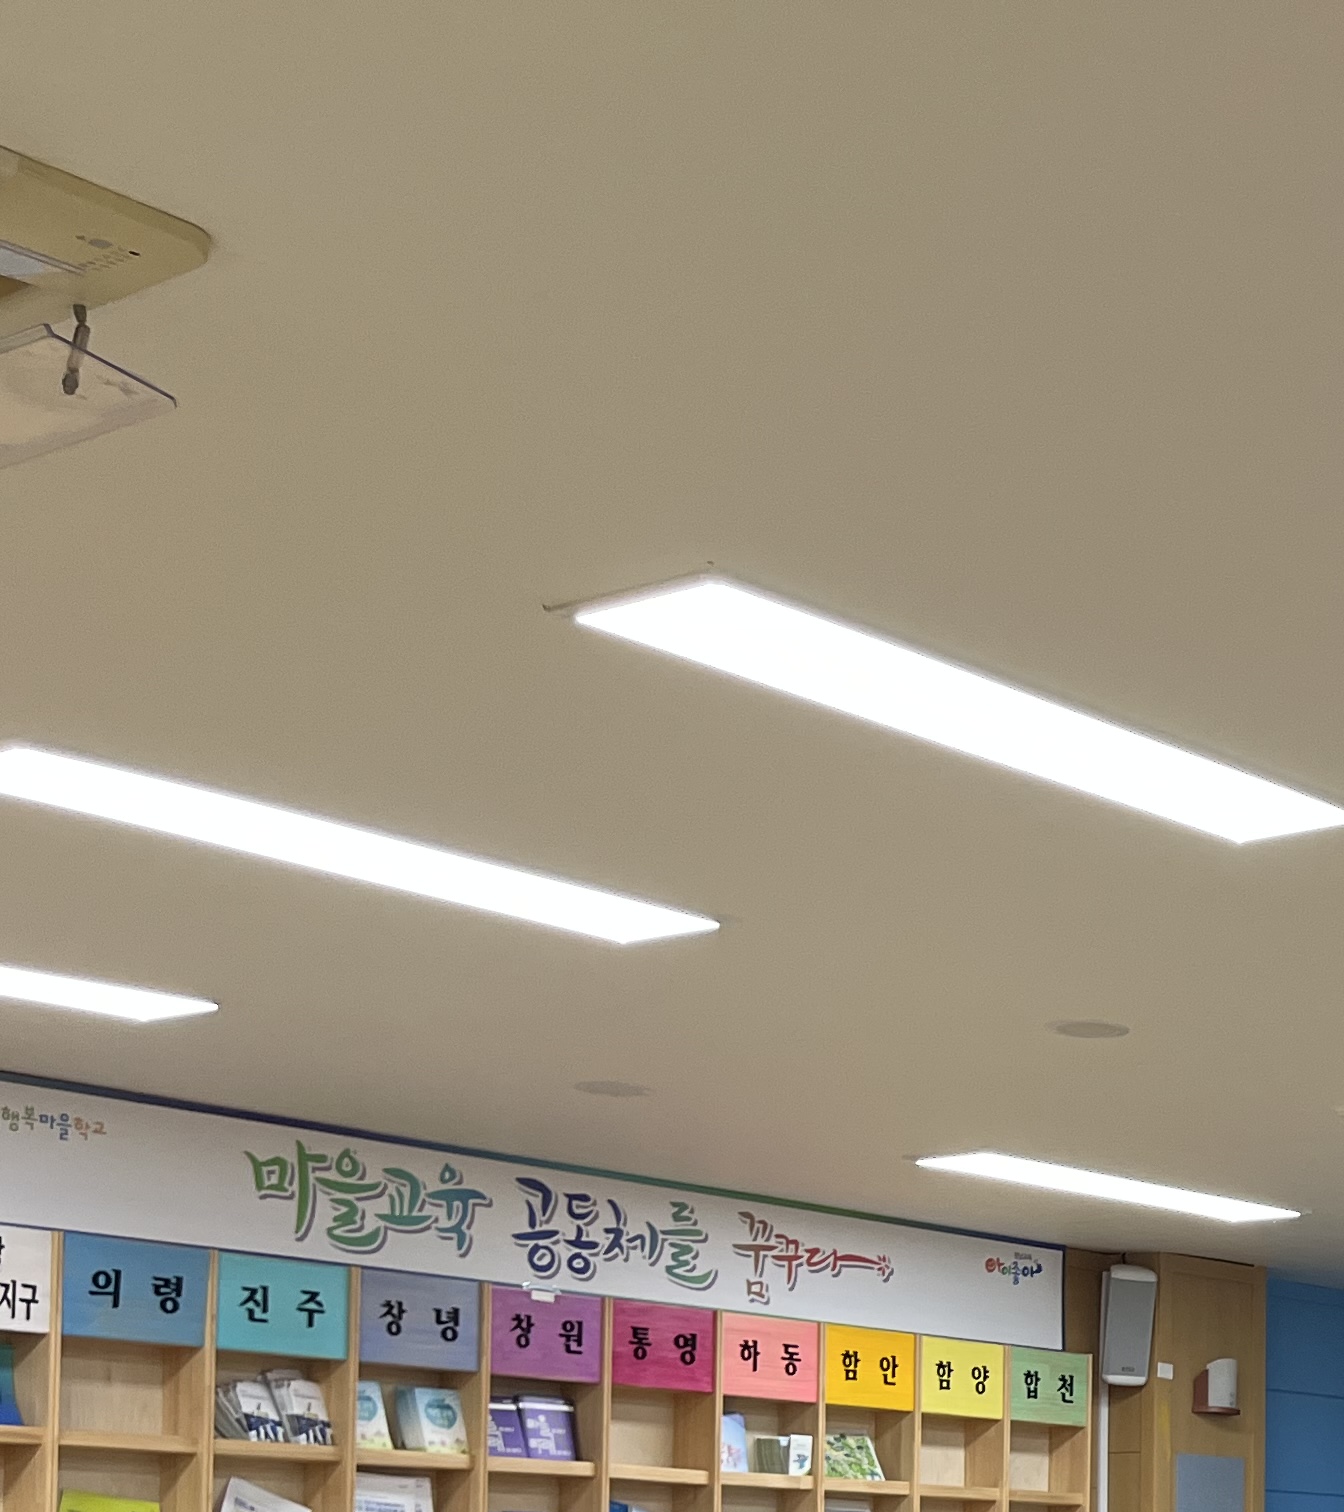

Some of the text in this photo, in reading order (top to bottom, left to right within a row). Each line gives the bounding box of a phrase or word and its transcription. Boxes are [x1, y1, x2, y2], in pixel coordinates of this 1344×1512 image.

[1, 1106, 107, 1141] 행복마을학교
[244, 1139, 893, 1304] 마을교육 공동체를 꿈꾸다
[88, 1269, 184, 1314] 의령
[239, 1285, 325, 1328] 진주
[378, 1299, 459, 1341] 창녕
[510, 1313, 584, 1355] 창원
[628, 1326, 698, 1366] 통영
[739, 1339, 802, 1377] 하동
[840, 1350, 899, 1387] 함안
[935, 1361, 990, 1395] 함양
[1023, 1369, 1075, 1404] 합천
